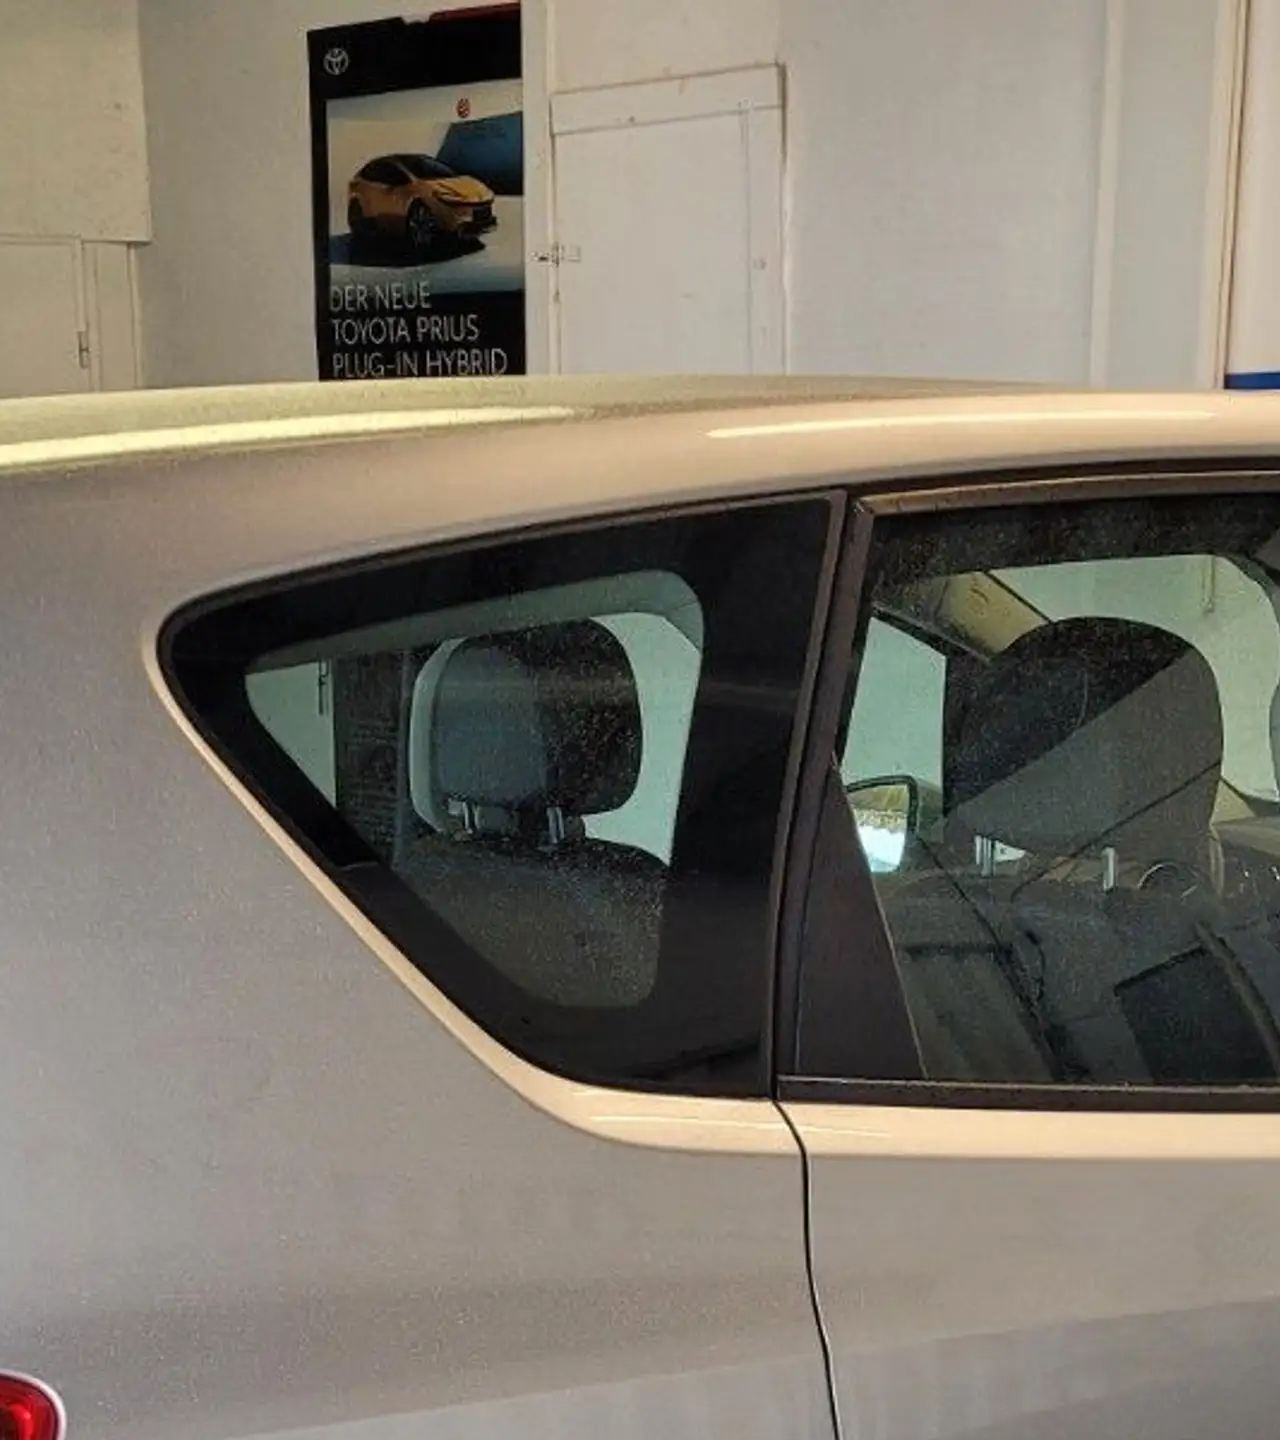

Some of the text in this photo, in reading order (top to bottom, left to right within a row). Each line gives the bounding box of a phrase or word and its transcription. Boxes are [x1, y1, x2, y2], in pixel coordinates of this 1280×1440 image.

[330, 279, 433, 313] DER NEUE
[331, 313, 481, 346] TOYOTA PRIUS
[332, 347, 508, 380] PLUG-IN HYBRID
